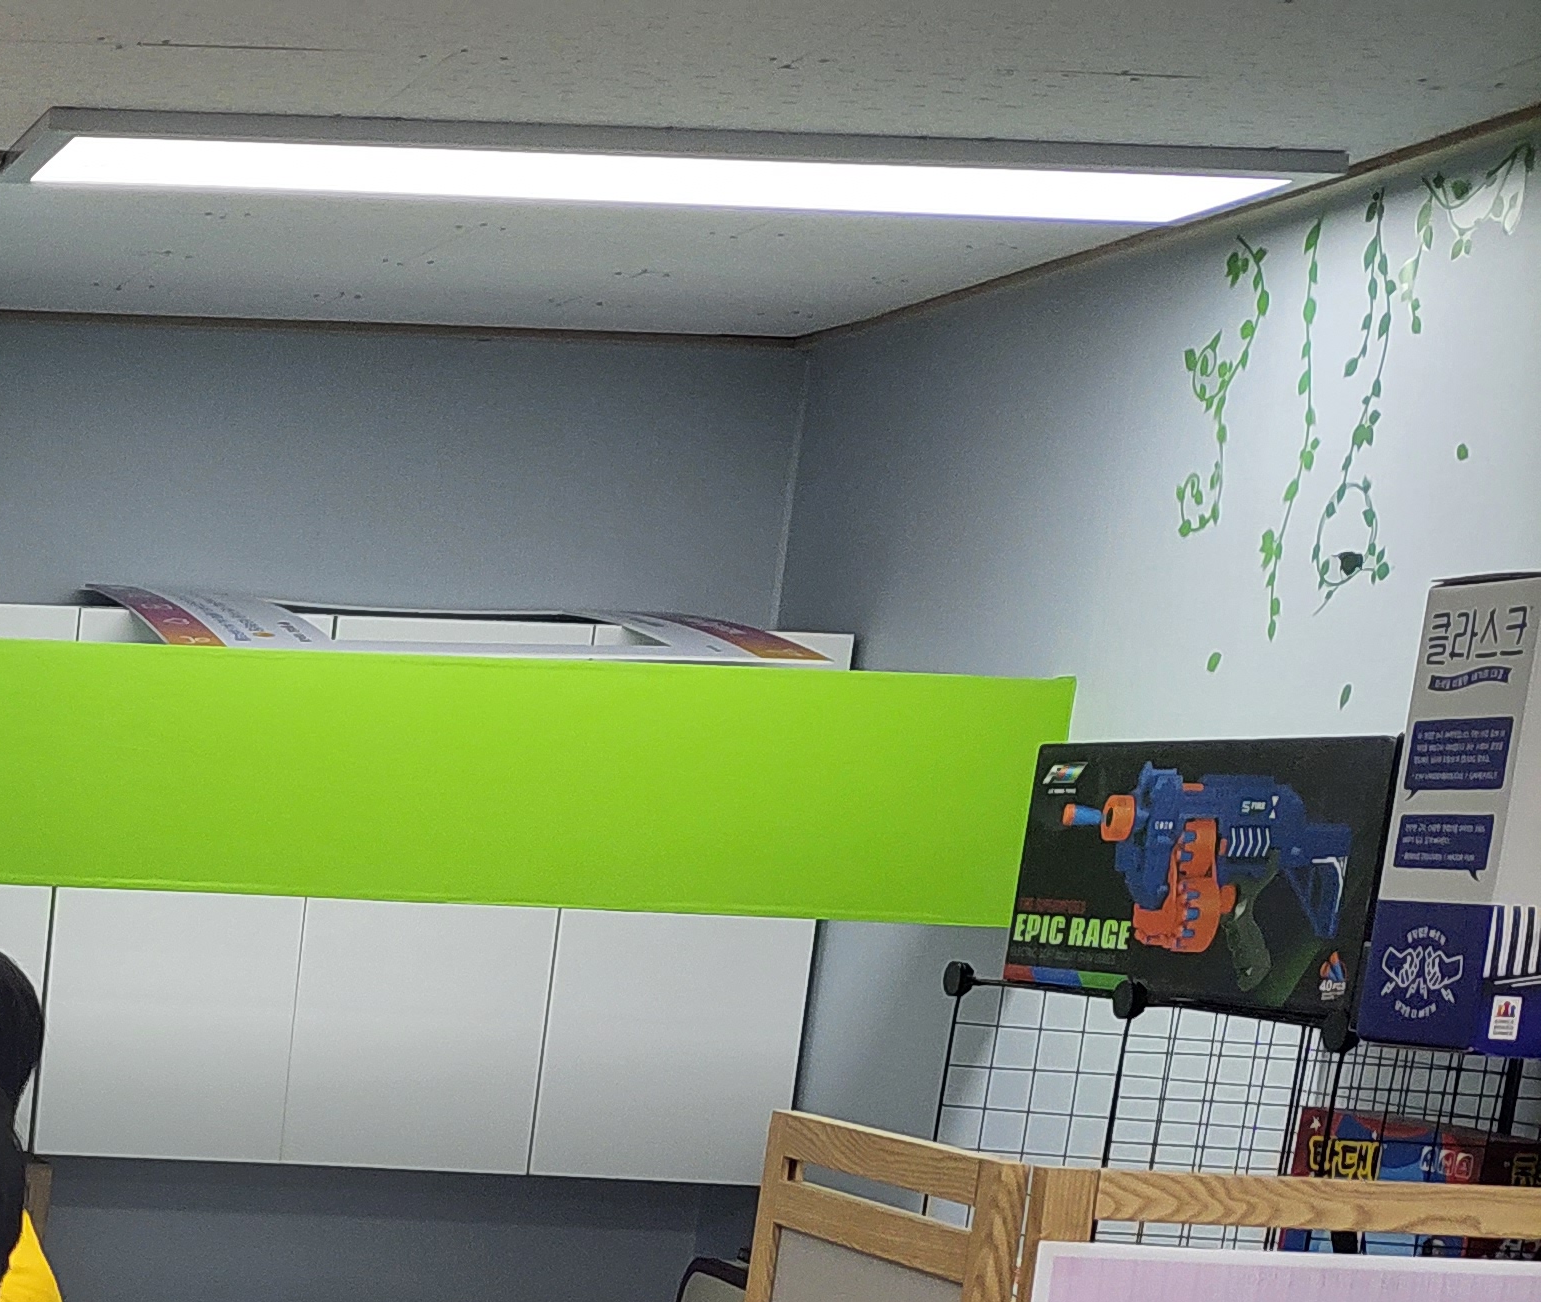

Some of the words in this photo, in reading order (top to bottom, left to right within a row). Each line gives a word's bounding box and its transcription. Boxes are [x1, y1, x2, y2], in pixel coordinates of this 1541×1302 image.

[1425, 605, 1528, 666] 클라스크
[1012, 913, 1066, 945] EPIC
[1067, 916, 1132, 950] RAGE
